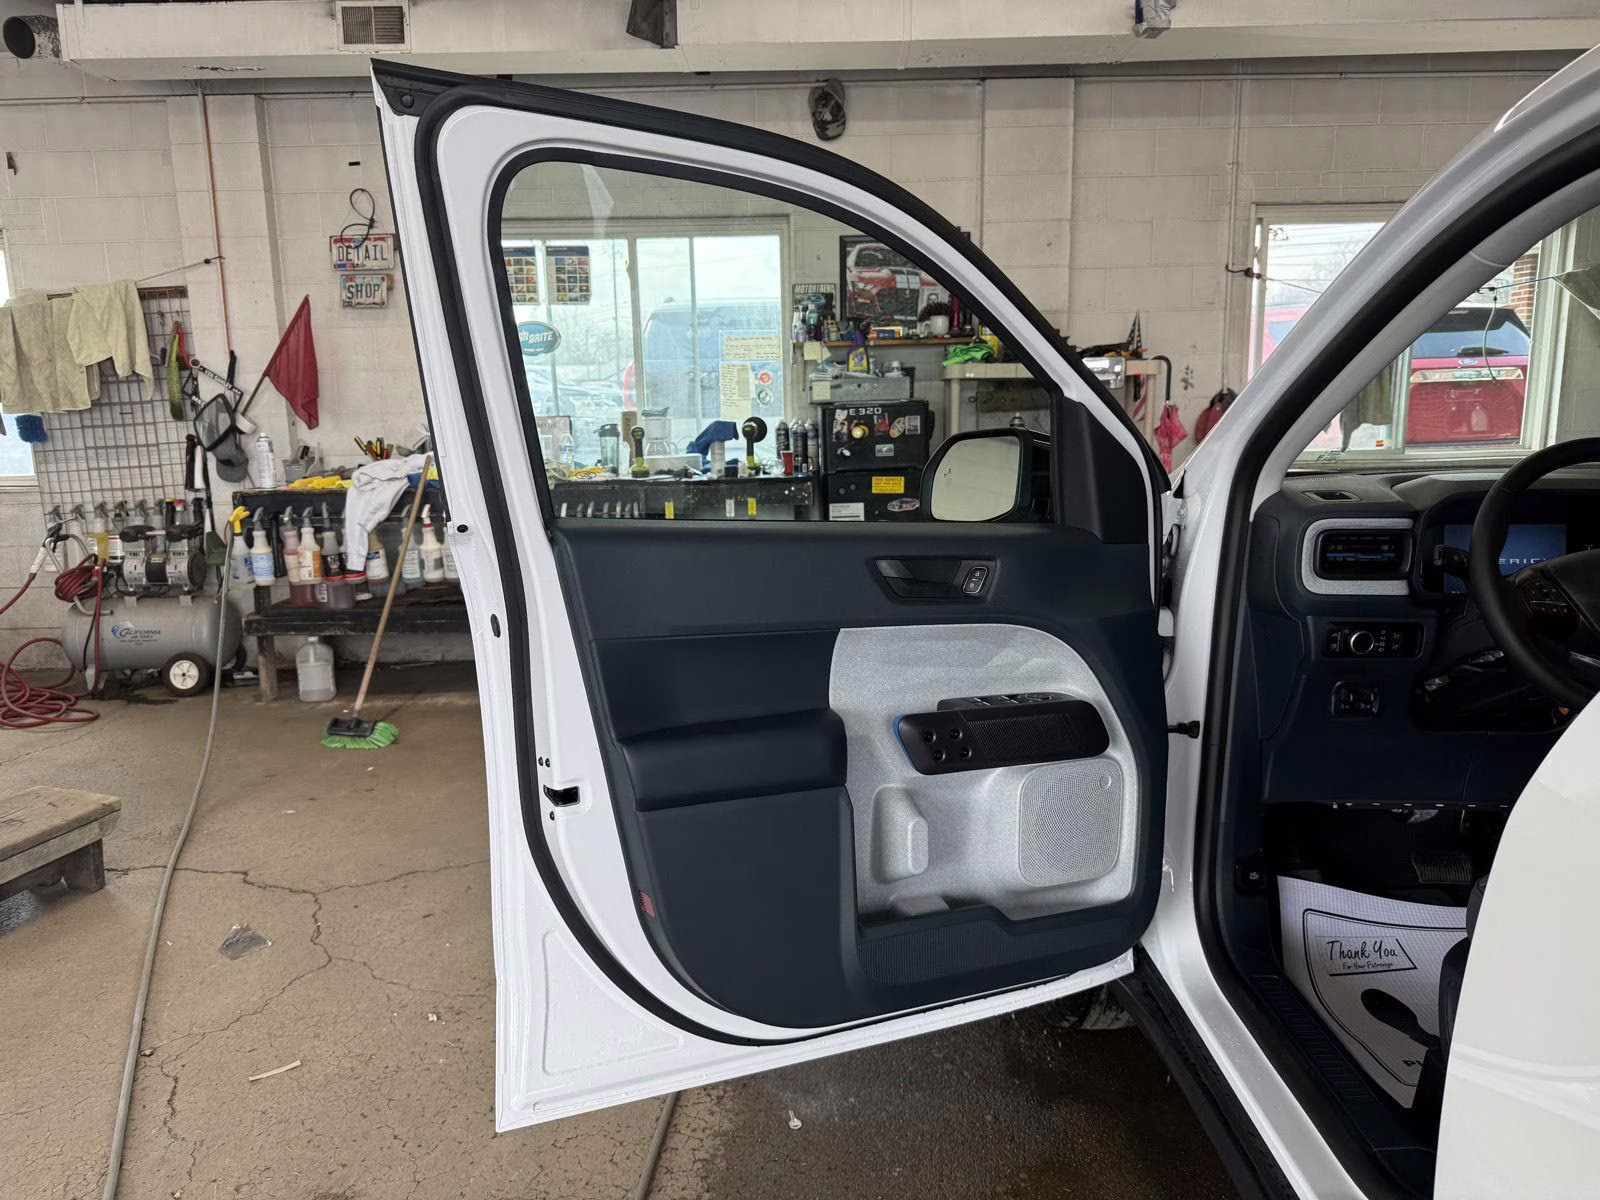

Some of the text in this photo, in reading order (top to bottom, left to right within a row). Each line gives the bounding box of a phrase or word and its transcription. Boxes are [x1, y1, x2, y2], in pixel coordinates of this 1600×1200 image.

[337, 244, 387, 262] DETAIL
[346, 283, 381, 300] SHOP
[119, 628, 161, 638] CALIFORNIA
[1326, 940, 1399, 961] Thank You
[1342, 962, 1352, 970] For
[1353, 962, 1366, 970] Your
